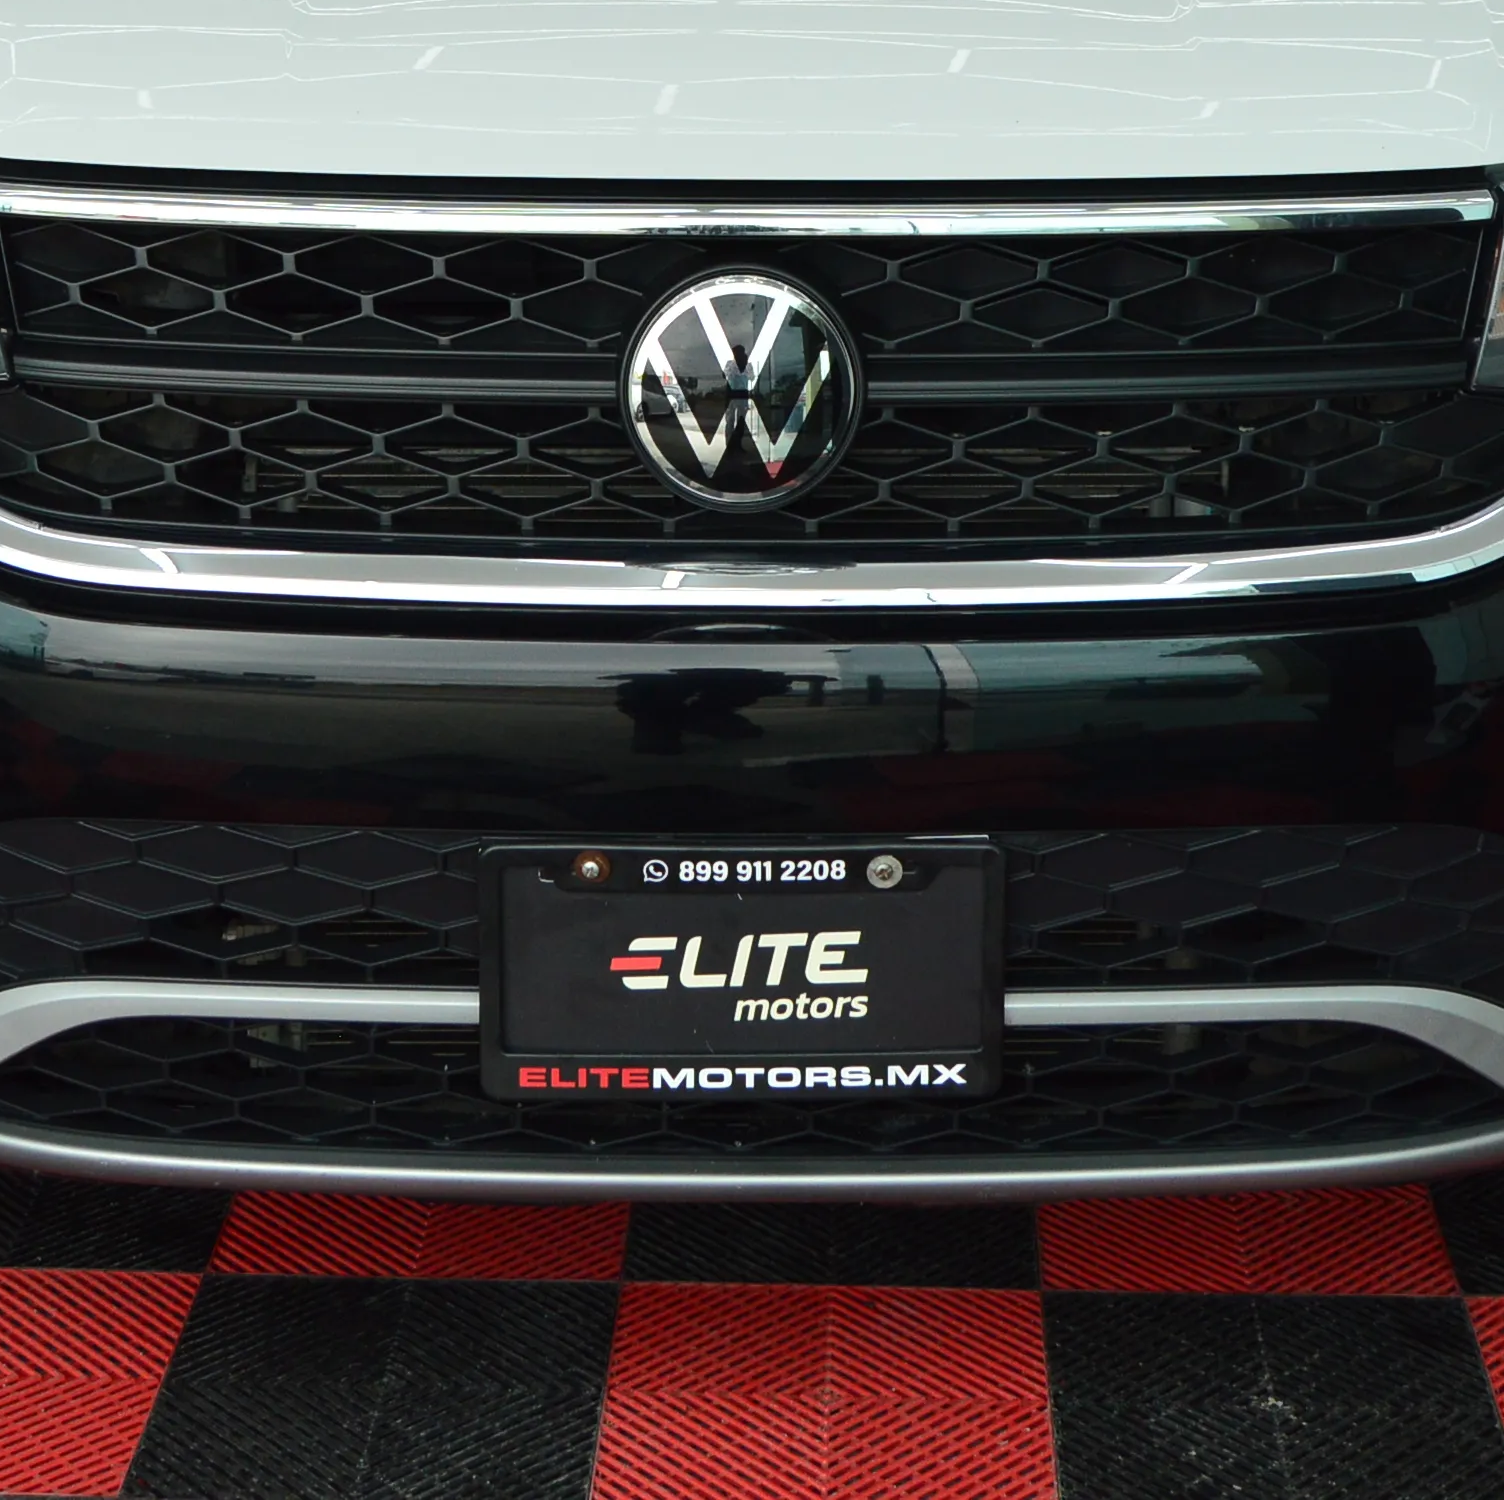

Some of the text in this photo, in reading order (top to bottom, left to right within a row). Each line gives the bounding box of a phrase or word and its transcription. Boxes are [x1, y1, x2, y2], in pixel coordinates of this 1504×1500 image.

[678, 859, 847, 882] 899 911 2208
[609, 930, 869, 991] ELITE
[733, 992, 869, 1022] motors
[517, 1062, 968, 1090] ELITEMOTORS.MX
